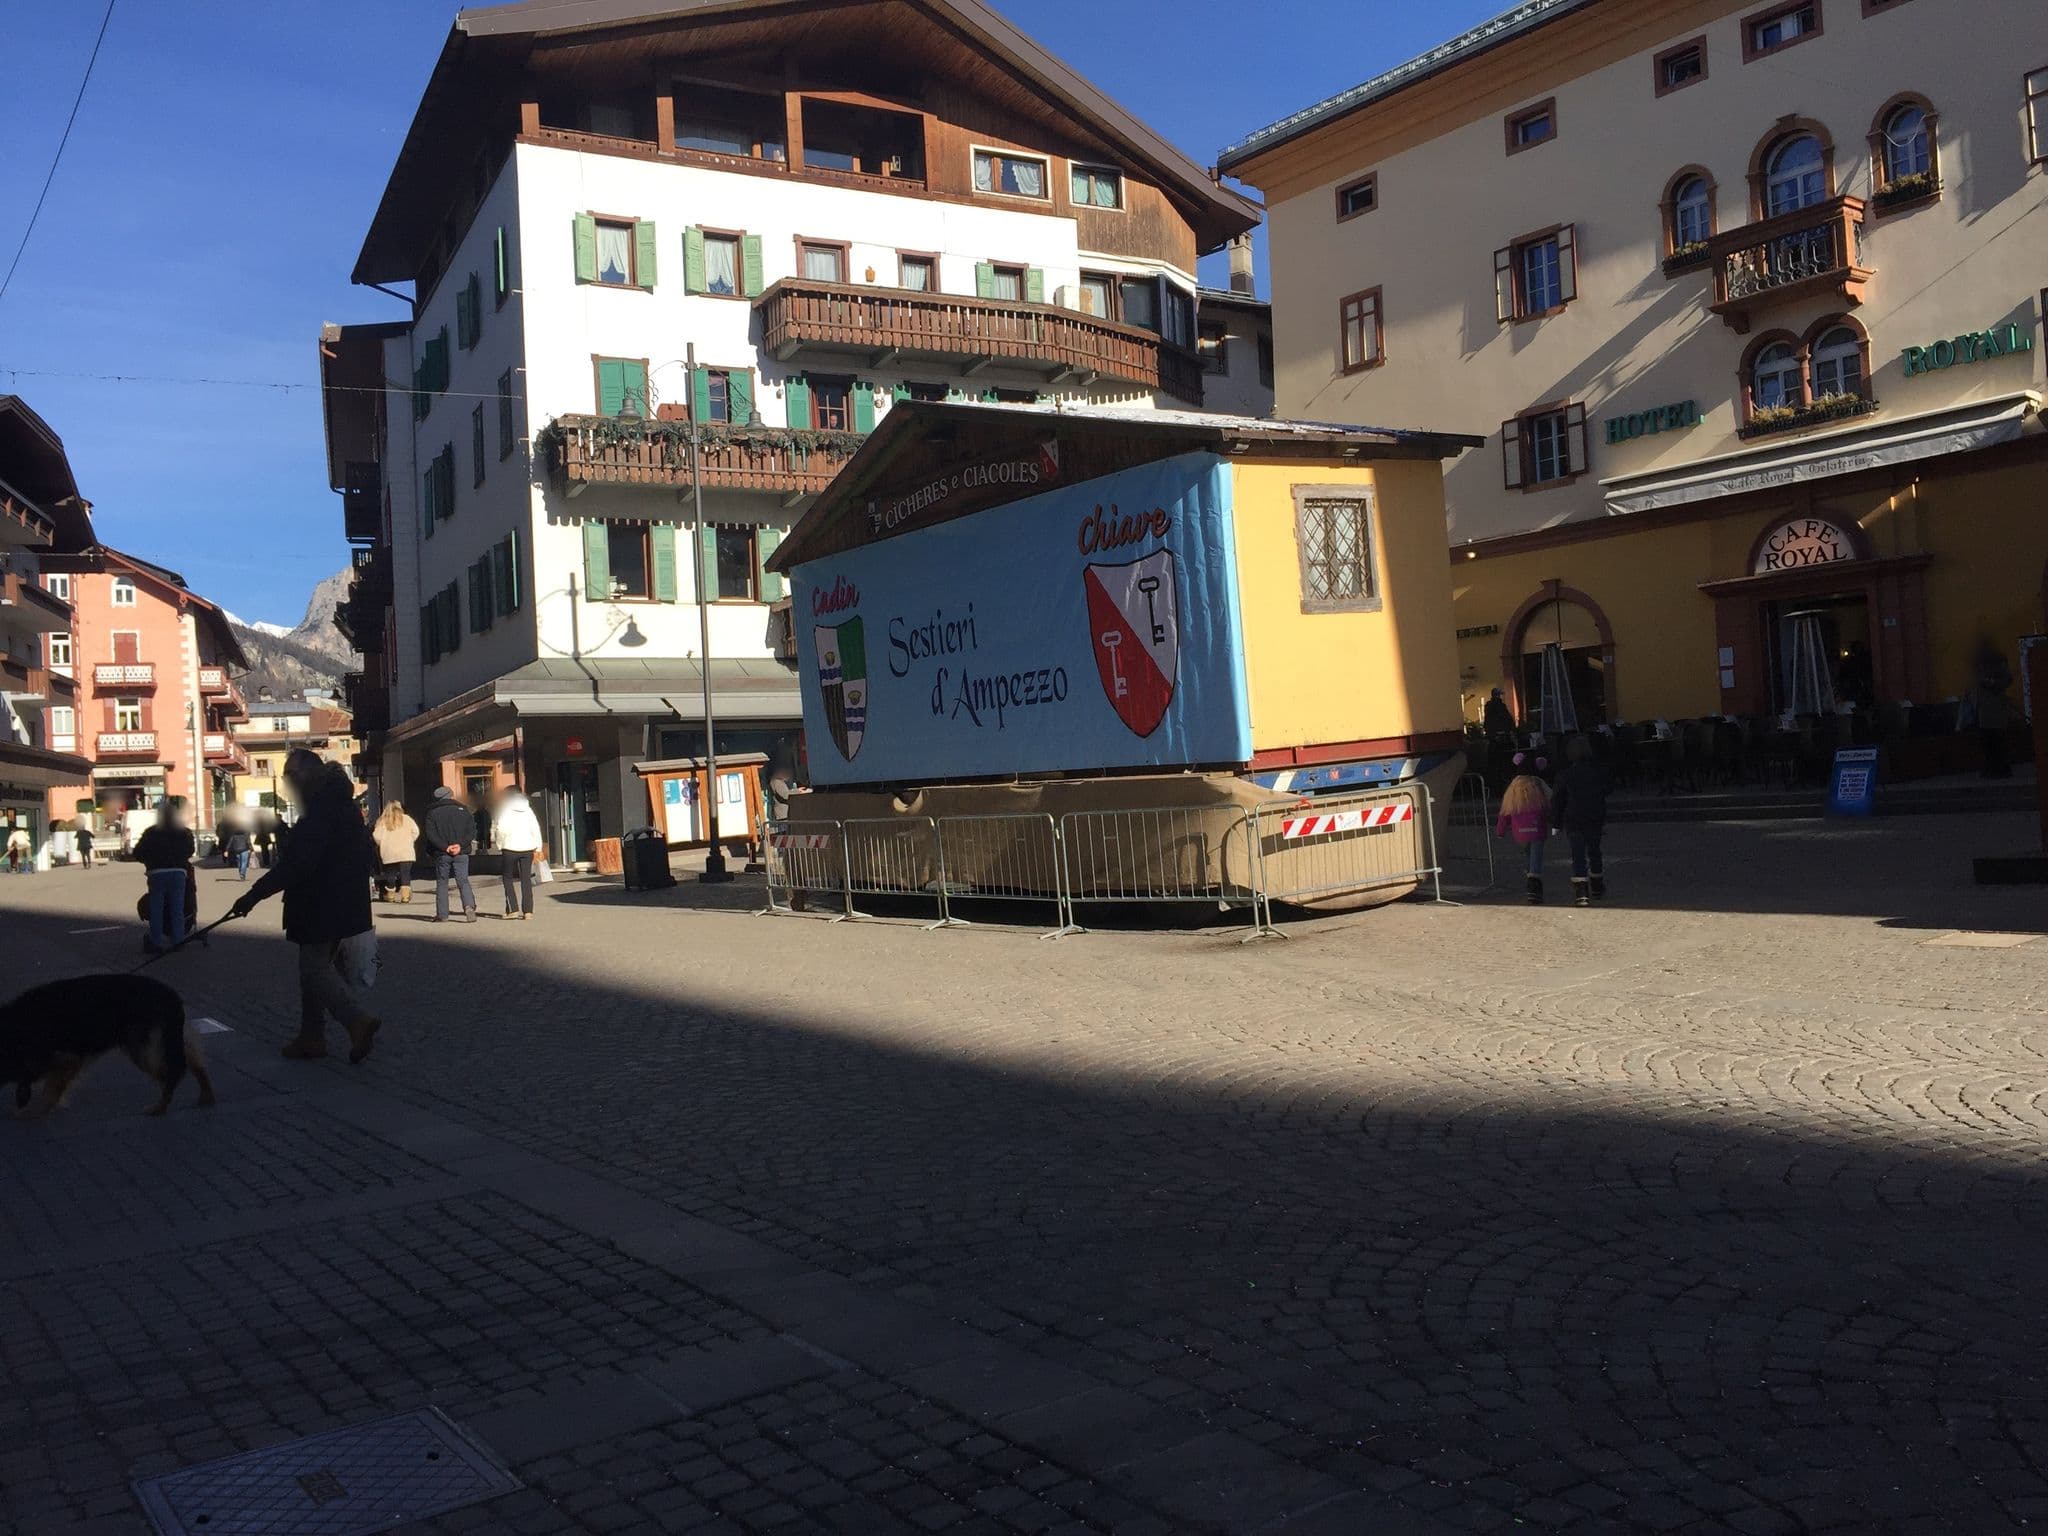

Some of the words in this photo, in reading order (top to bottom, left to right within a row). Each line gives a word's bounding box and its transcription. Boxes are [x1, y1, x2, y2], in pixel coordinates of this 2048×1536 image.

[1604, 399, 1705, 445] HOTEL
[1901, 321, 2032, 378] ROYAL
[951, 475, 960, 489] e
[963, 461, 1040, 488] CIACOLES
[1077, 503, 1172, 556] Chiave
[1764, 542, 1848, 571] ROYAL
[888, 602, 979, 678] Sestieri
[931, 664, 1069, 731] d'Ampezzo
